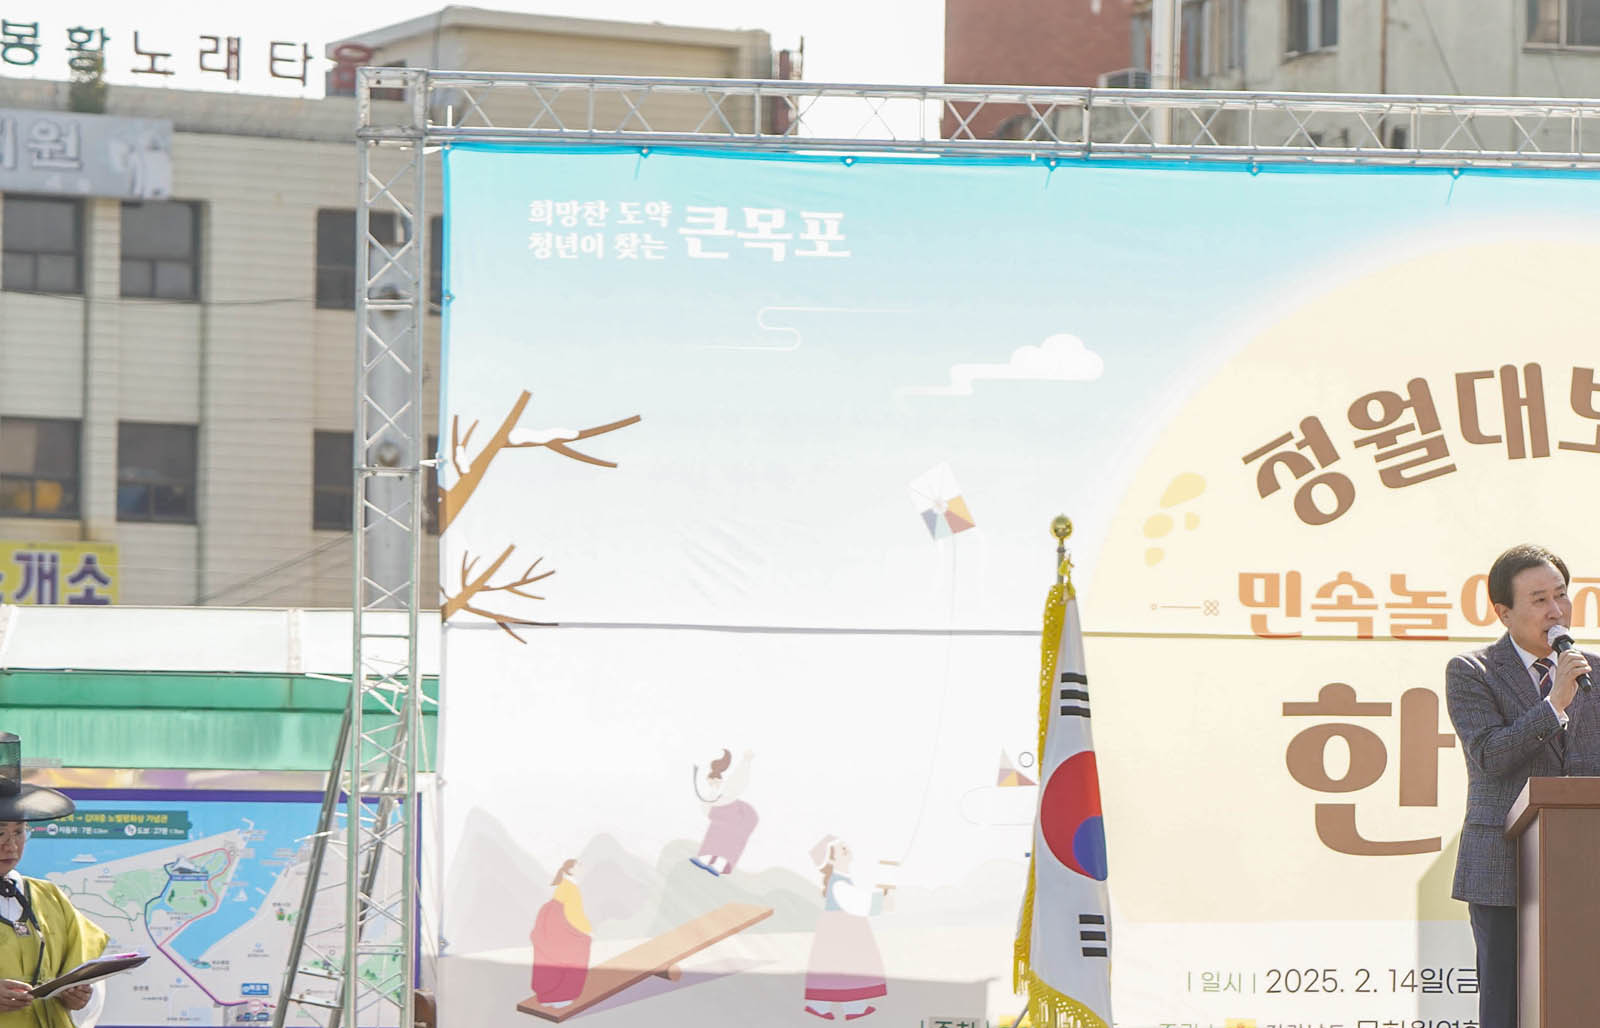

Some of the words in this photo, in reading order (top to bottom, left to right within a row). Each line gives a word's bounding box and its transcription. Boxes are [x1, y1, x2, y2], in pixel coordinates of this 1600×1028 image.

[528, 200, 609, 228] 희망찬
[617, 200, 673, 228] 도약
[528, 232, 604, 260] 청년이
[614, 233, 668, 260] 찾는
[678, 204, 850, 262] 큰목포
[0, 552, 111, 606] 개소
[1201, 971, 1242, 992] 일시
[1265, 968, 1345, 993] 2025.
[1354, 969, 1378, 993] 2.
